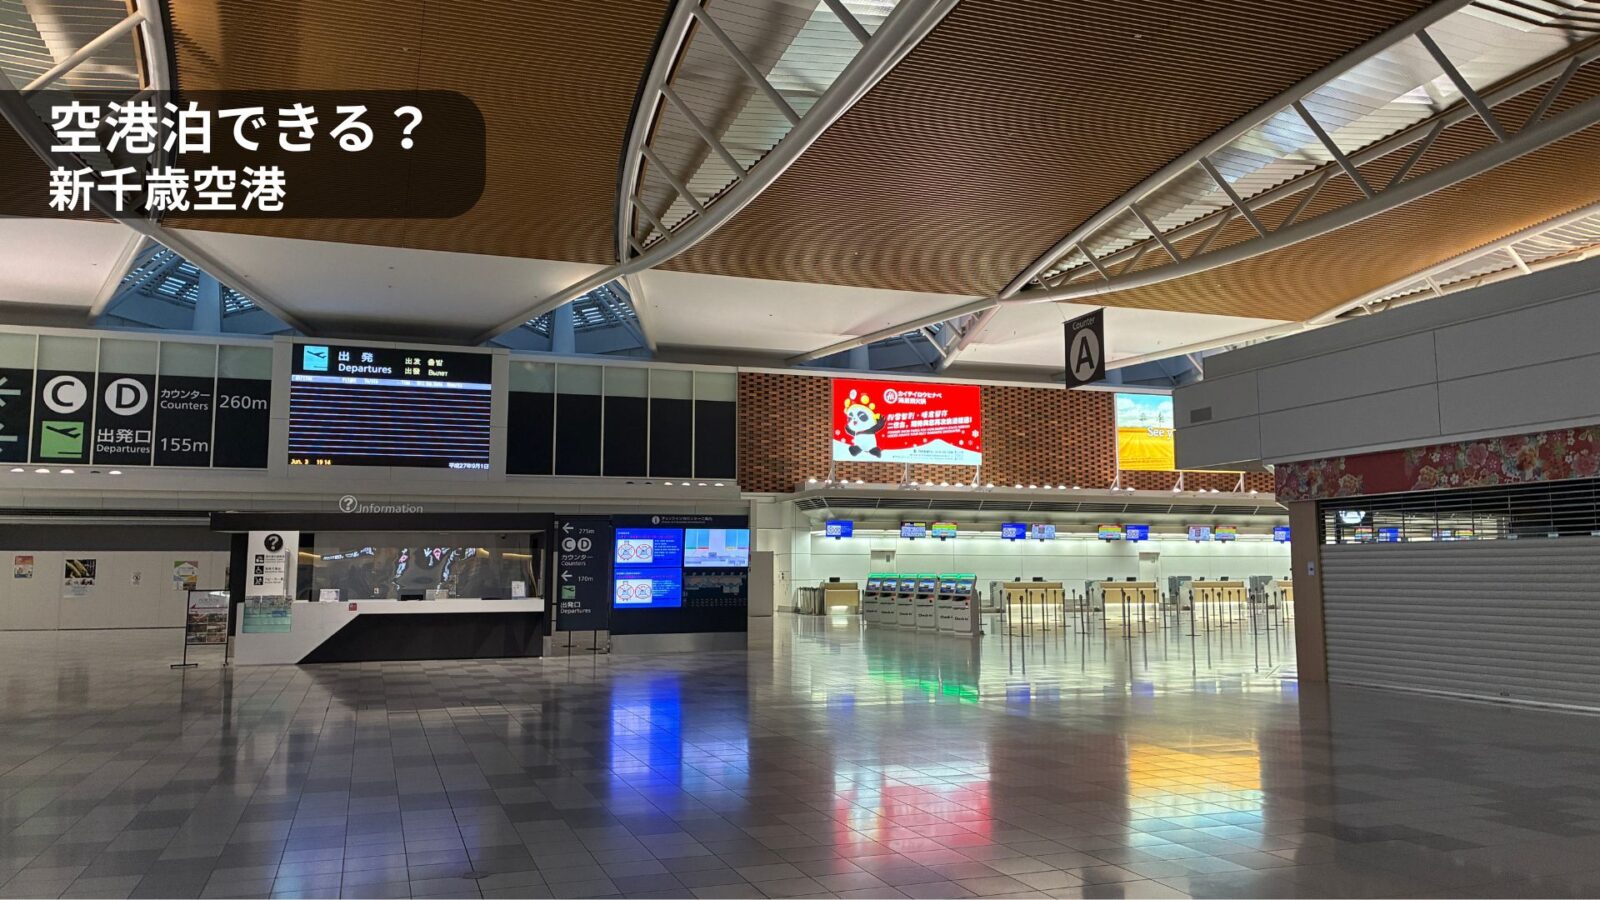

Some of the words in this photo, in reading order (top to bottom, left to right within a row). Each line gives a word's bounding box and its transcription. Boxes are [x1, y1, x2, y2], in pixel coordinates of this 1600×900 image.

[1072, 317, 1095, 330] Counter
[1076, 336, 1095, 373] A
[338, 363, 392, 375] Departures
[51, 381, 75, 407] C
[115, 383, 141, 408] D
[160, 389, 211, 400] カウンター
[160, 401, 209, 411] Counters
[219, 395, 268, 410] 260m
[97, 429, 152, 443] 出発口
[1147, 426, 1165, 437] See
[96, 444, 151, 454] Departures
[160, 438, 209, 452] 155m
[358, 502, 424, 514] Information
